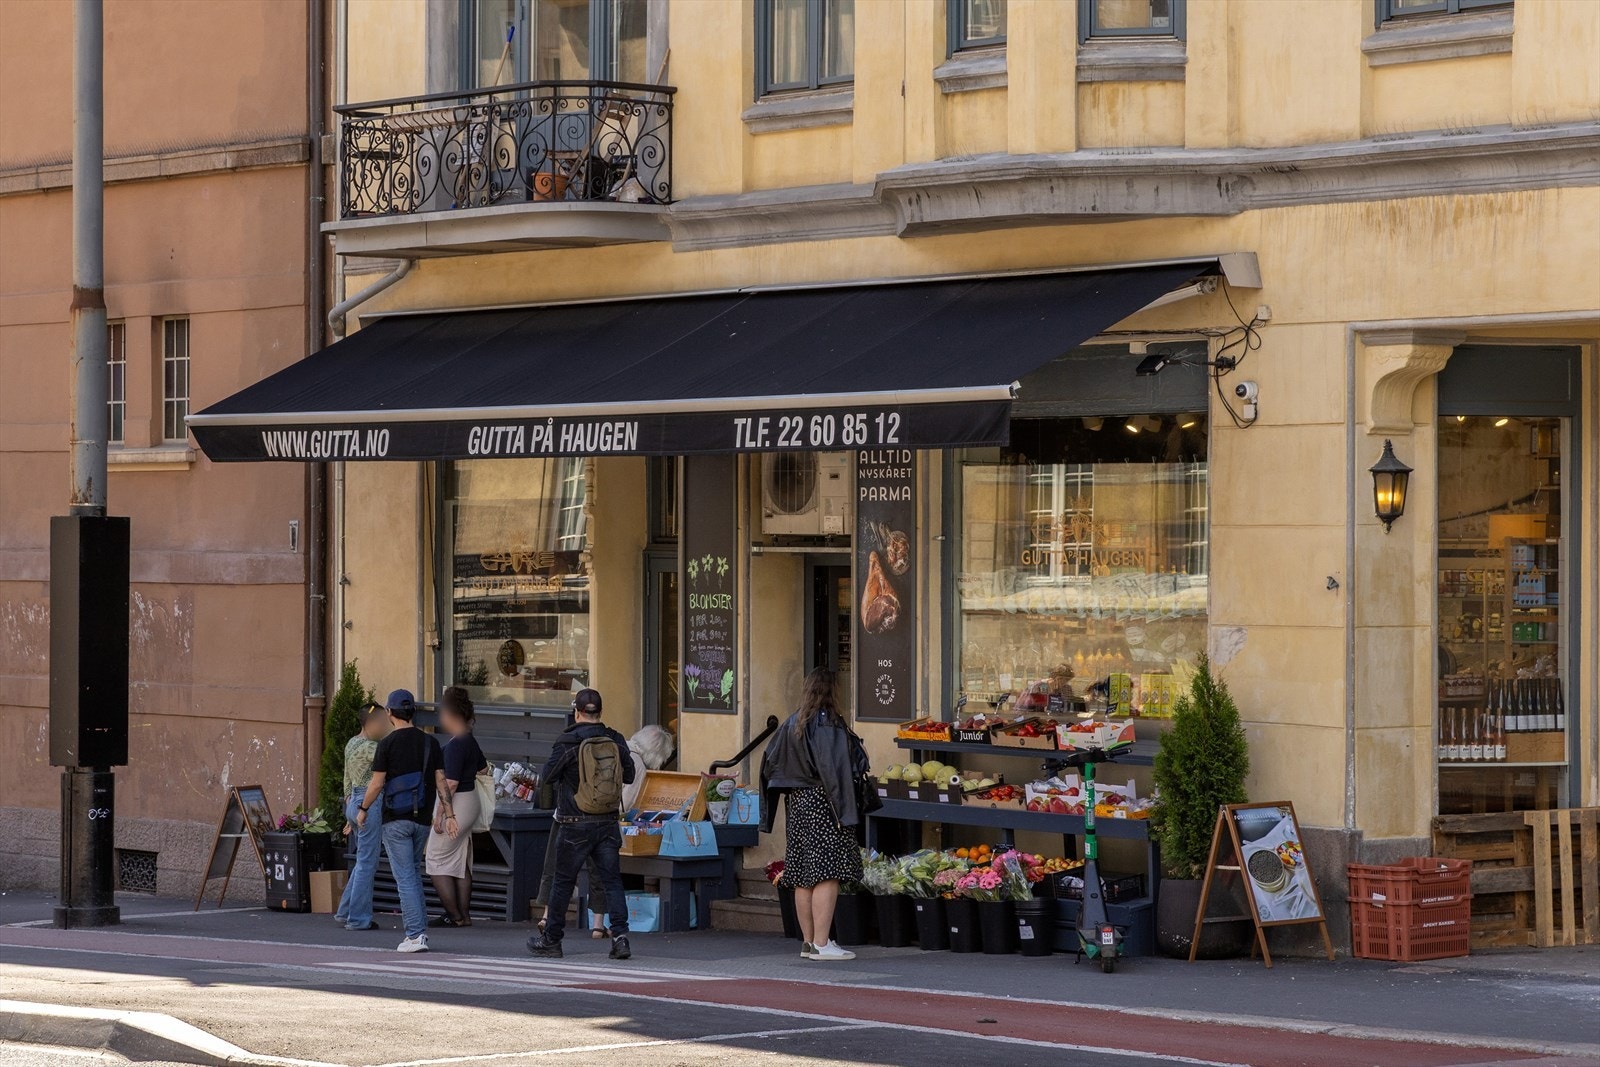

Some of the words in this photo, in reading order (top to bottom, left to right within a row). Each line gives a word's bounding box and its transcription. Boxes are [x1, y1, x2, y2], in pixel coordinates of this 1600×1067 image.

[467, 425, 525, 455] GUTTA
[530, 417, 554, 453] PÅ
[559, 421, 639, 453] HAUGEN
[733, 417, 771, 448] TLF.
[777, 416, 804, 447] 22
[809, 414, 836, 446] 60
[842, 413, 868, 445] 85
[875, 412, 901, 444] 12
[261, 428, 390, 458] WWW.GUTTA.NO
[859, 449, 912, 464] ALLTID
[859, 464, 912, 479] NYSKÅRET
[860, 485, 911, 501] PARMA
[1021, 549, 1069, 566] GUTTA
[1078, 549, 1142, 567] HAUGEN
[689, 593, 733, 610] BLOMSTER
[877, 659, 892, 667] HOS
[876, 674, 893, 684] GUTTA
[879, 688, 896, 705] HAUGEN
[959, 730, 984, 742] Junior
